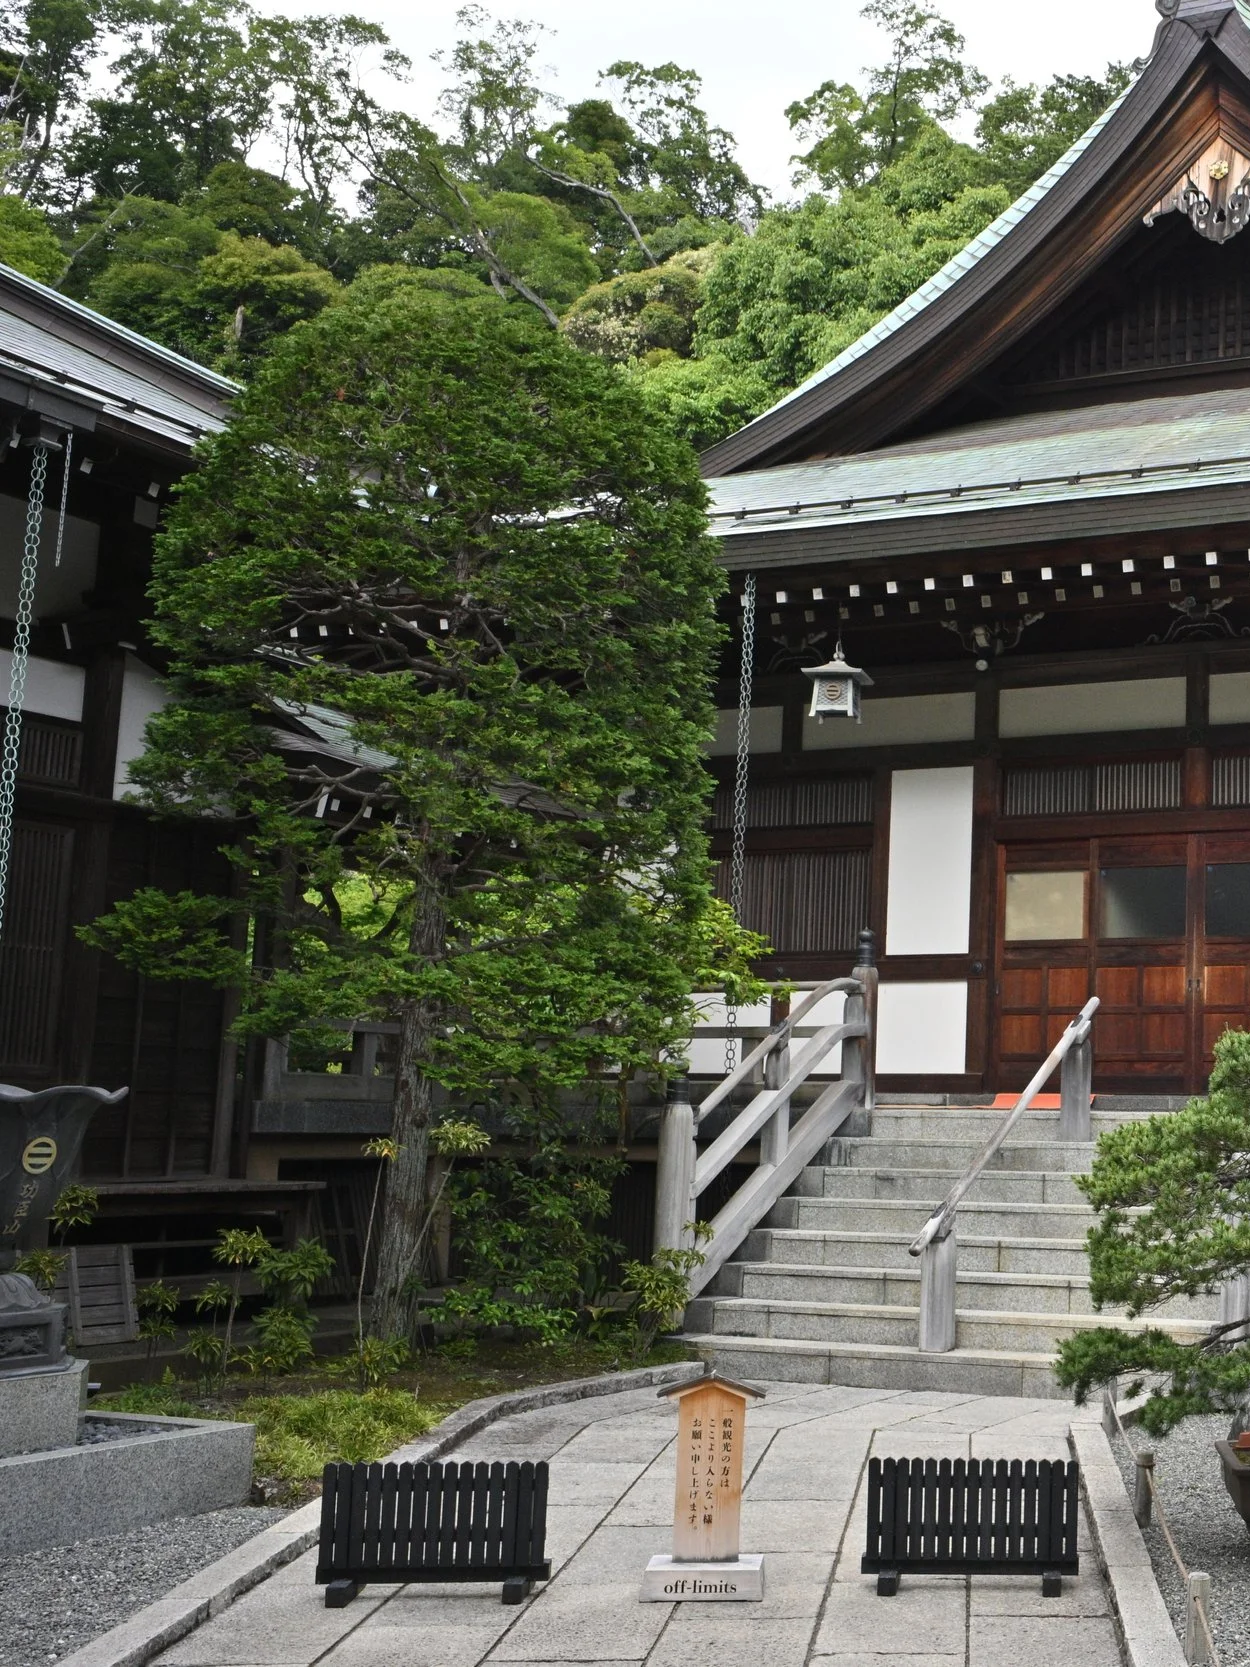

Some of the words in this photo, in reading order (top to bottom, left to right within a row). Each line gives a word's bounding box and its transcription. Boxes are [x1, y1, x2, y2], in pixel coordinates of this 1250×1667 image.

[688, 1418, 702, 1531] お願い申し上げます。
[703, 1419, 715, 1525] ここより入らない様
[720, 1409, 734, 1488] 一般観光の方は
[664, 1580, 737, 1593] off-limits
